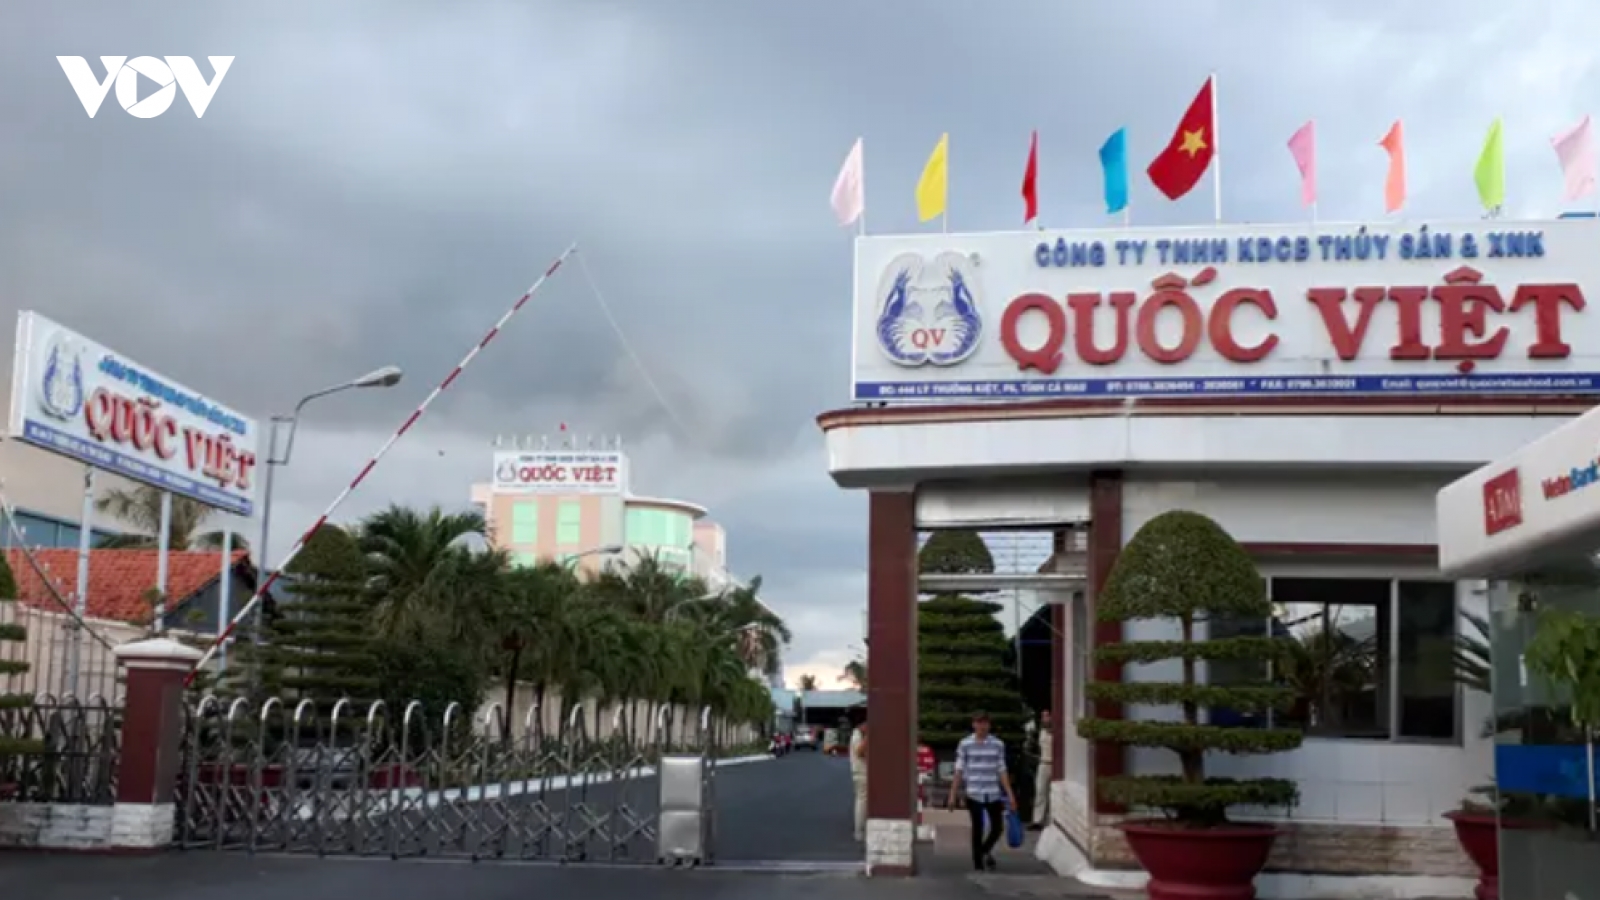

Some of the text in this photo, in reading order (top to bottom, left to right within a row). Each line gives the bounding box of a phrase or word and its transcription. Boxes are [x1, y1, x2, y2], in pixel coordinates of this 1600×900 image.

[1036, 237, 1106, 267] CÔNG
[1115, 240, 1147, 265] TY
[1155, 238, 1227, 264] TNHH
[1237, 235, 1310, 262] KDCB
[1460, 233, 1479, 257] &
[1488, 231, 1545, 257] XNK
[1000, 265, 1586, 374] QUỐC VIỆT
[911, 328, 946, 349] QV
[85, 386, 177, 460] QUỐC
[183, 427, 255, 489] VIỆT
[520, 463, 617, 482] QUỐC VIỆT
